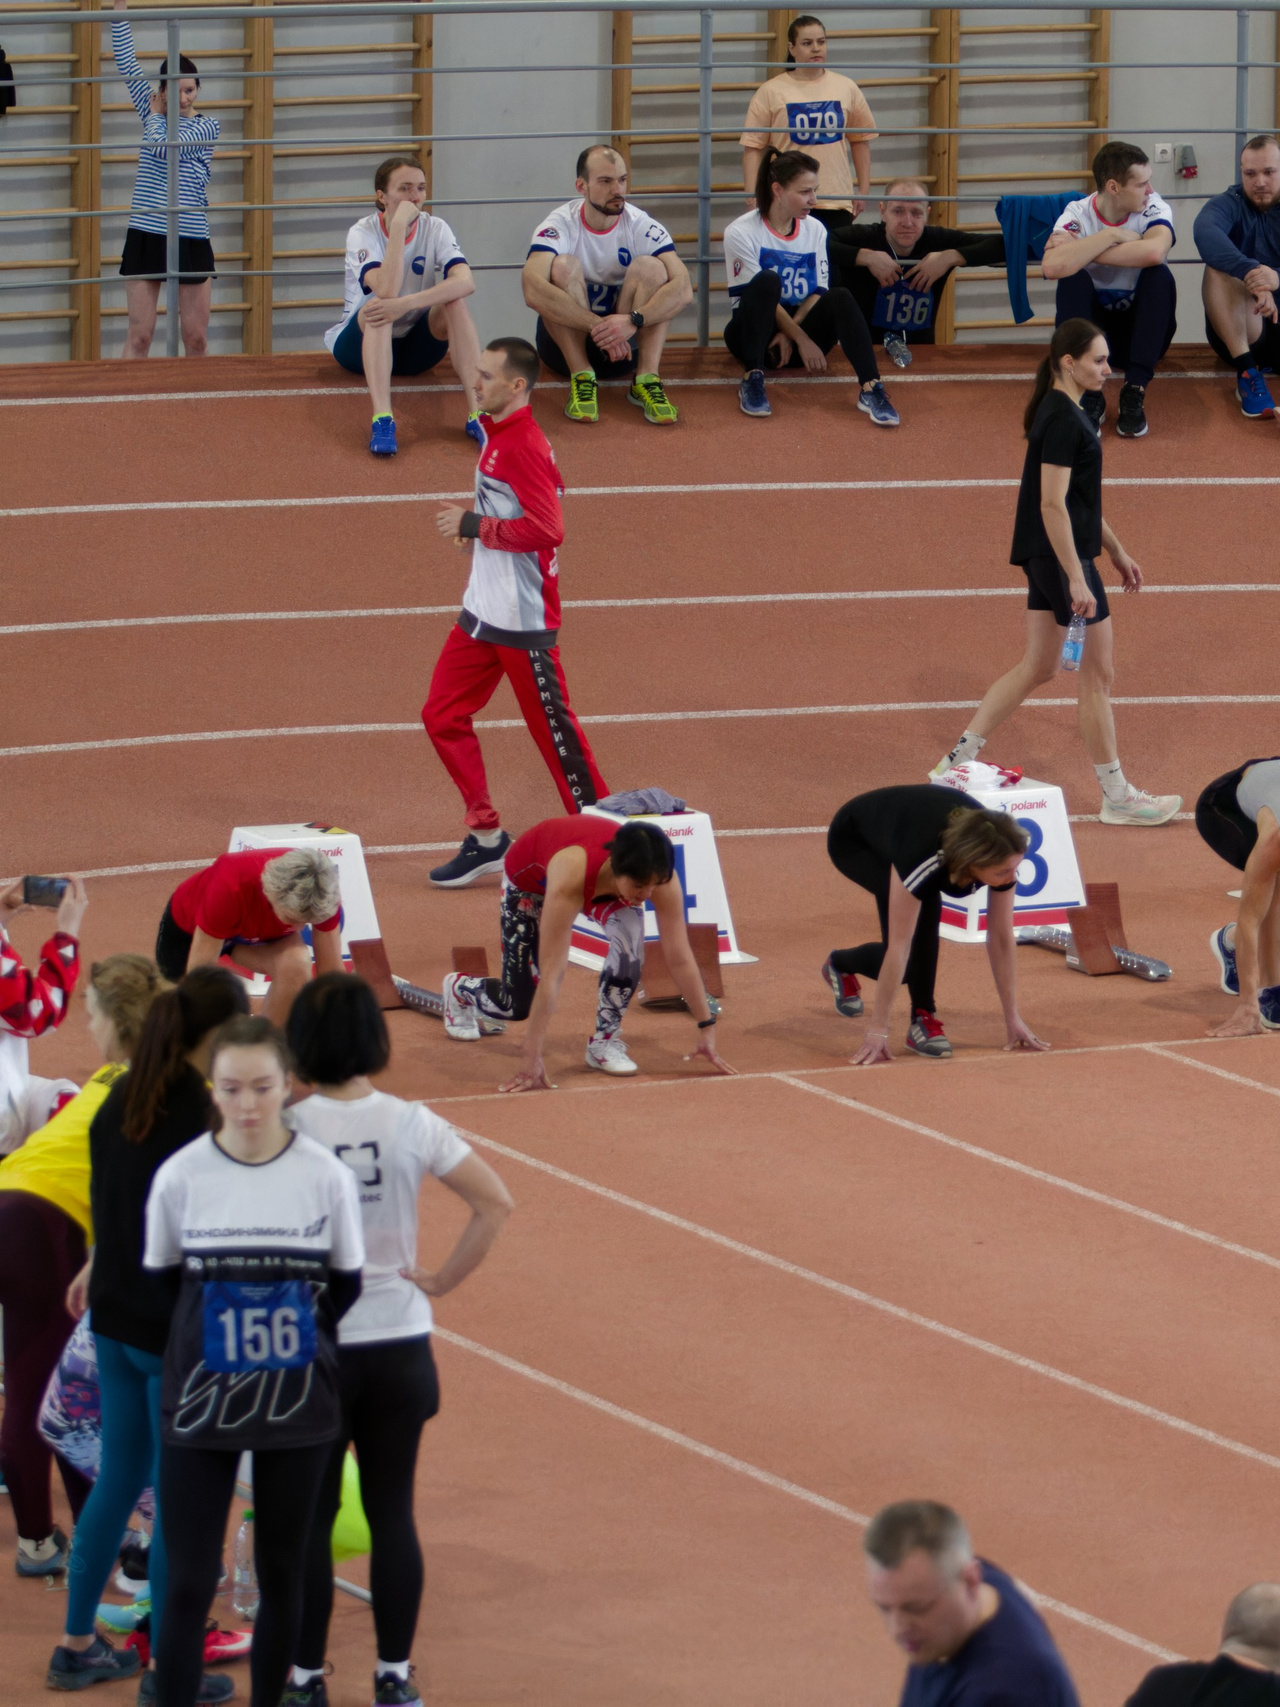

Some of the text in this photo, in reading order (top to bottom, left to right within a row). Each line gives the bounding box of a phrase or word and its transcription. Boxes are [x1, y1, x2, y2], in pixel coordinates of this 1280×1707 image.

[795, 111, 838, 141] 079
[886, 292, 930, 325] 136
[1010, 799, 1048, 813] polanik
[664, 825, 694, 838] olanik
[218, 1307, 300, 1362] 156
